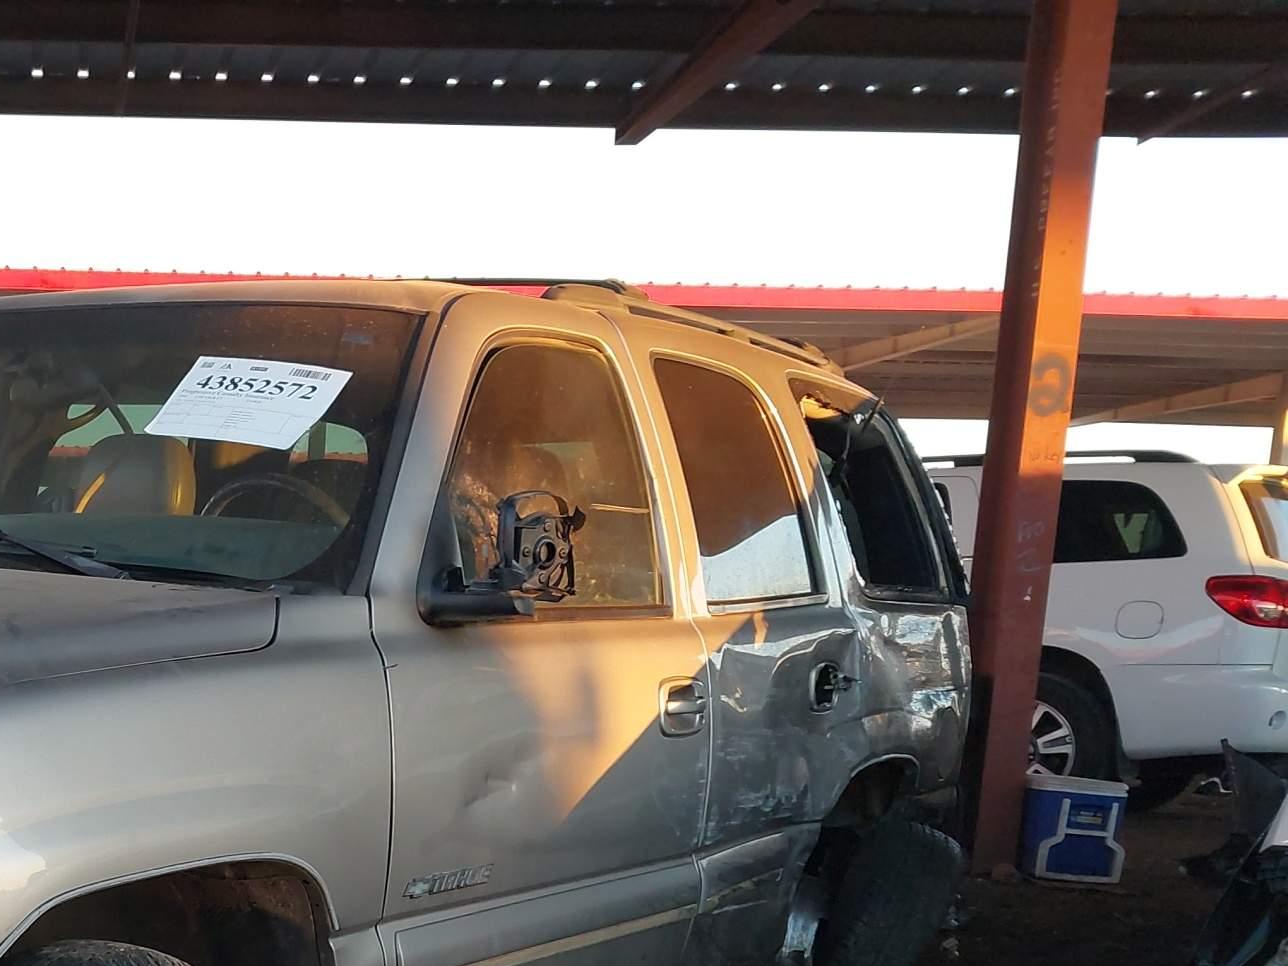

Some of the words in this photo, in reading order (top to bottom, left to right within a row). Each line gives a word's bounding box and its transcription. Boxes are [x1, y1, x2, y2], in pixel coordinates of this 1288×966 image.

[196, 374, 318, 400] 43852572
[1027, 351, 1070, 418] 2
[424, 863, 494, 895] TAHOE
